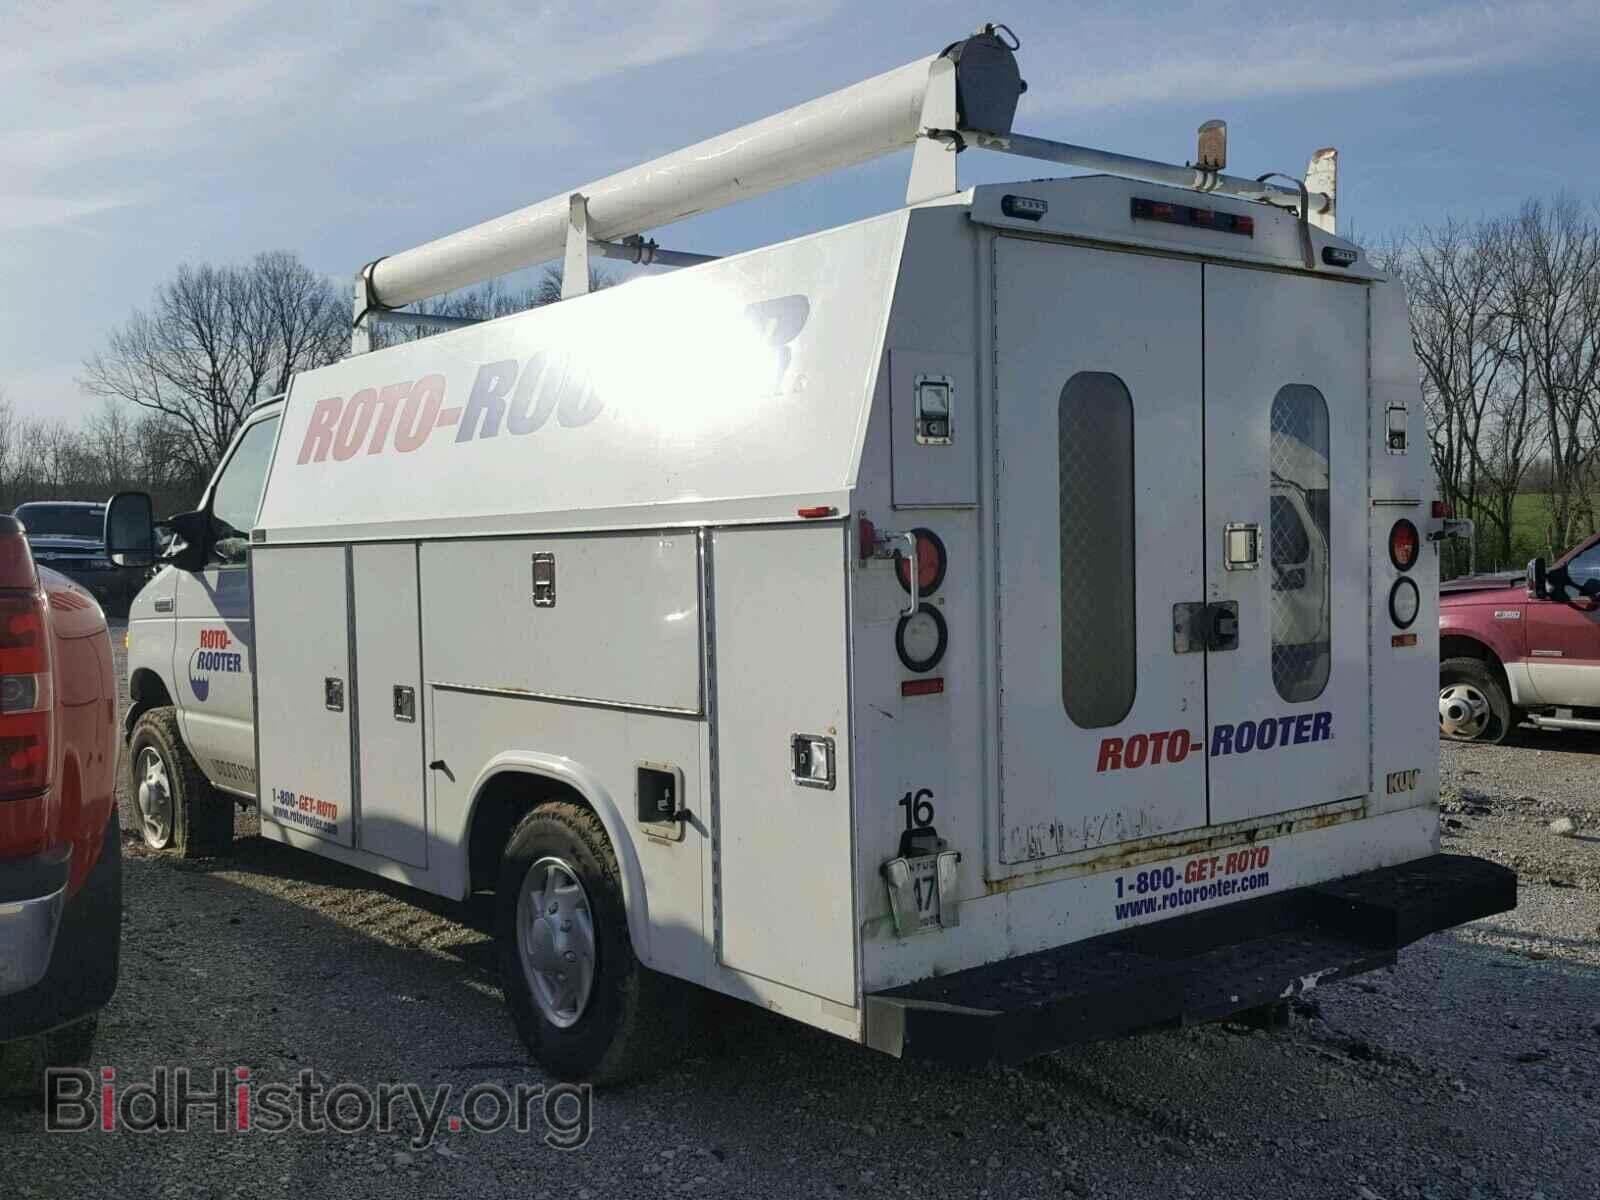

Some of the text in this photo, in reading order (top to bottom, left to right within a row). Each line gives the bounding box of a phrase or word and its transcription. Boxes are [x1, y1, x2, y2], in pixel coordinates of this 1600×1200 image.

[200, 629, 232, 650] ROTO-
[197, 651, 242, 673] ROOTER
[898, 788, 934, 832] 16
[1115, 871, 1269, 921] www.rotorooter.com
